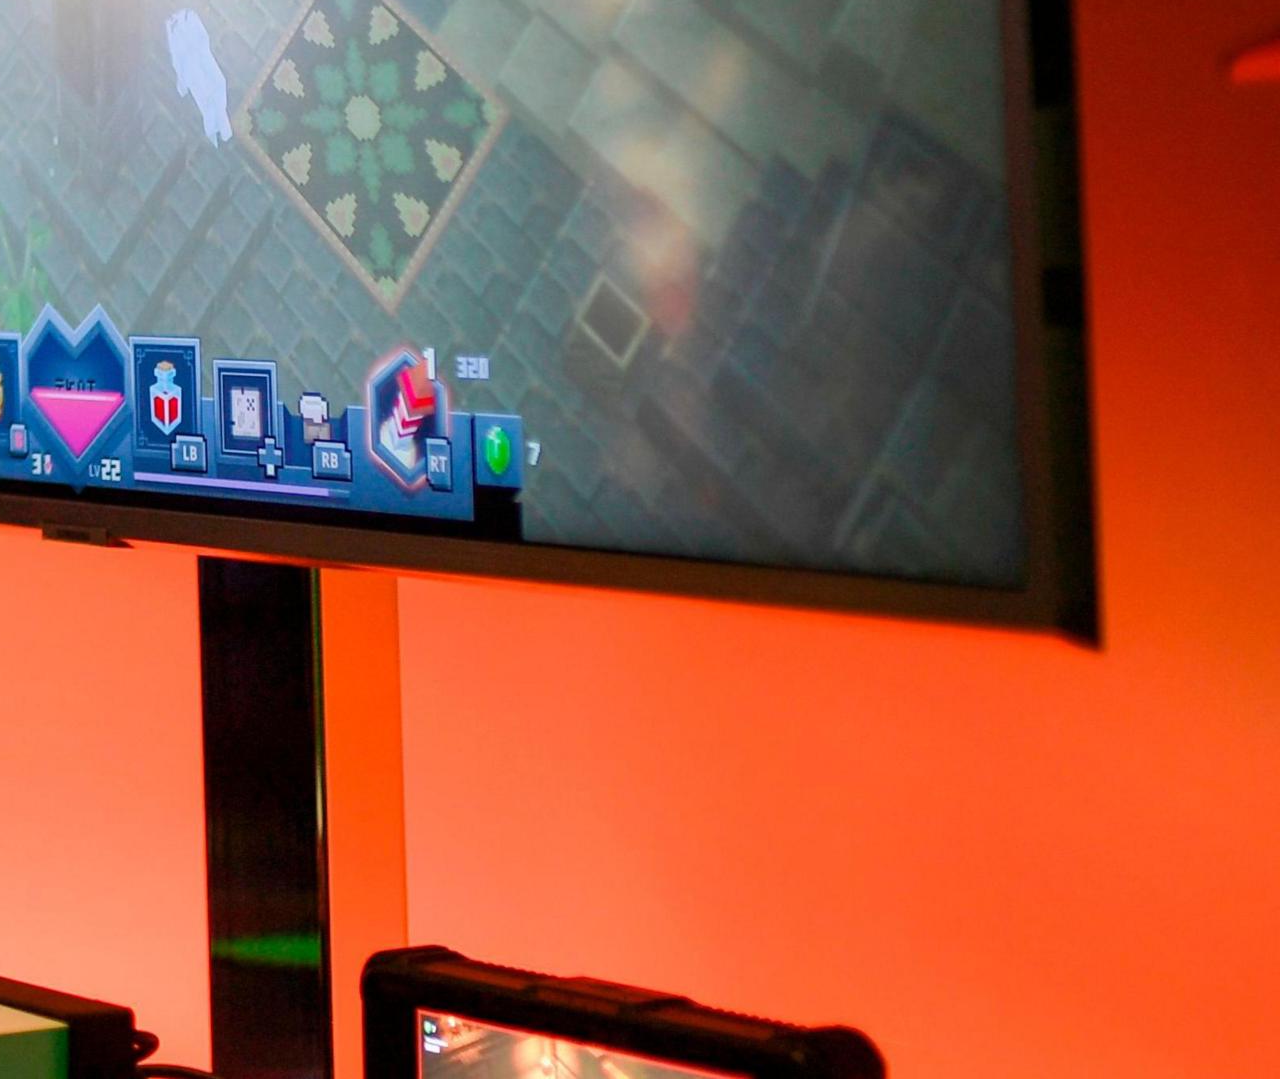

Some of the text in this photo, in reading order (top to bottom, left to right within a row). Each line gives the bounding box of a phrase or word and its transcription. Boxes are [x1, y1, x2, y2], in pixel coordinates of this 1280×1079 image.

[423, 347, 436, 381] 1
[456, 356, 490, 380] 320
[182, 444, 198, 462] LB
[321, 451, 339, 469] RB
[527, 441, 541, 466] 7
[430, 456, 448, 473] RT
